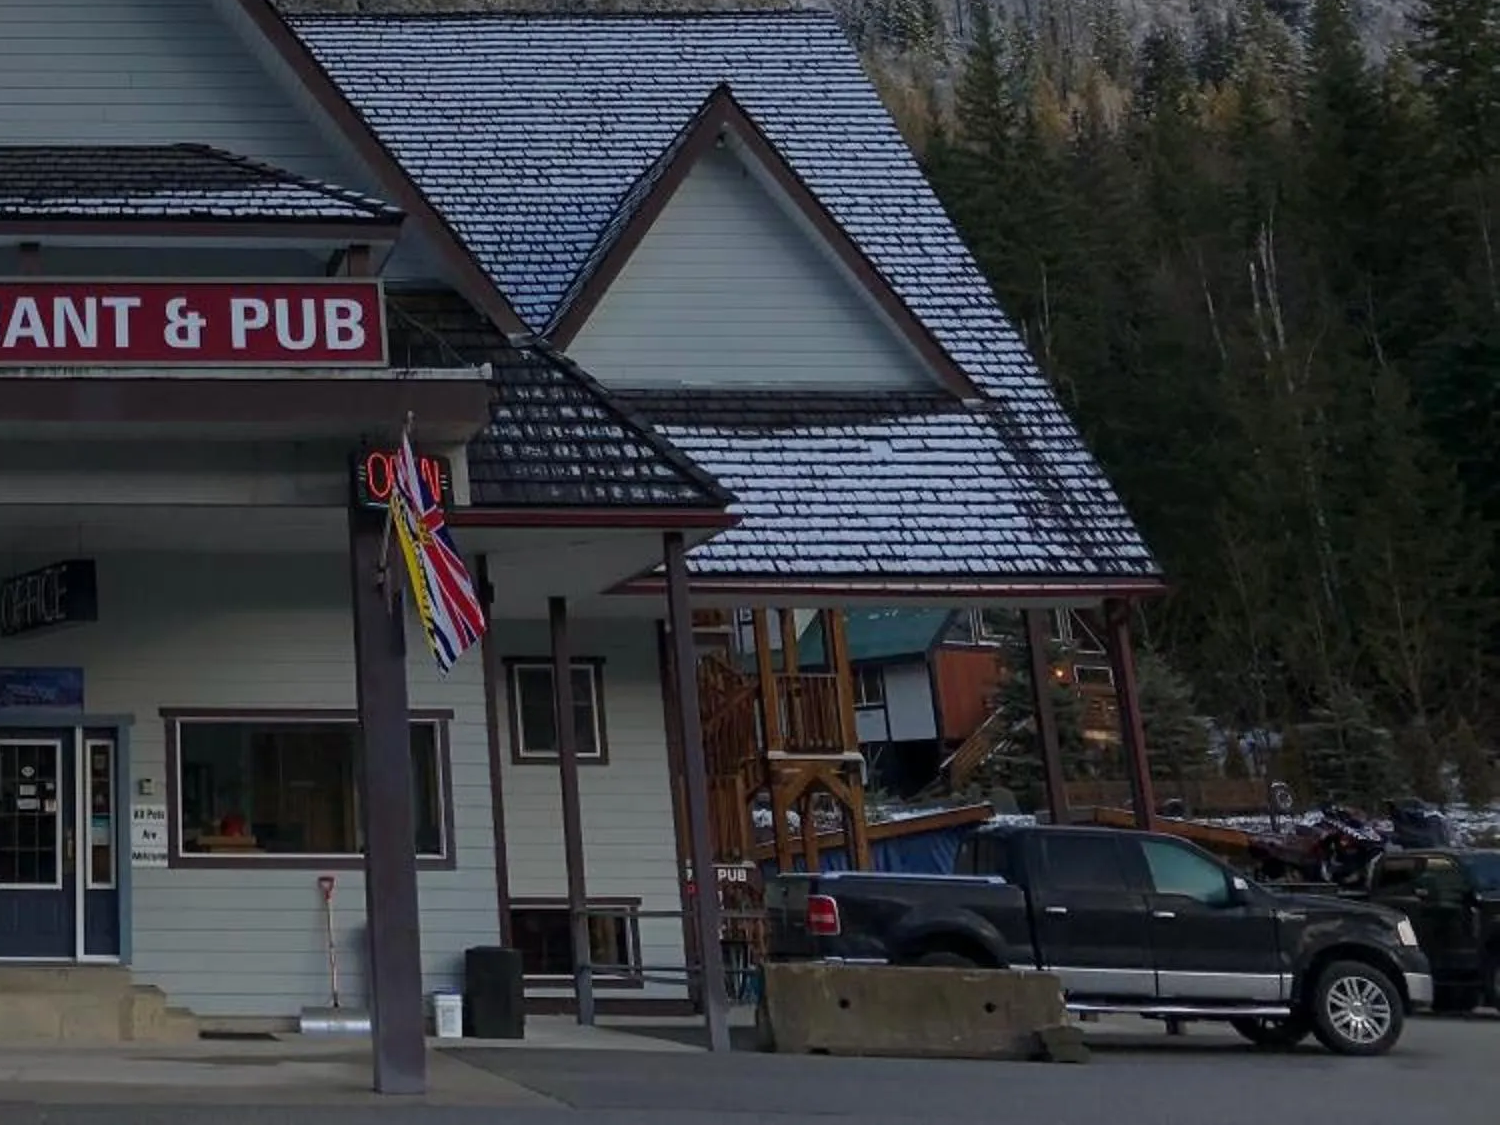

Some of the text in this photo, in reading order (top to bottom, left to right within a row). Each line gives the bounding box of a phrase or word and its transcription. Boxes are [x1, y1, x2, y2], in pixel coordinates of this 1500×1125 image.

[163, 297, 207, 349] &
[230, 297, 366, 351] PUB
[1, 565, 67, 630] OFFICE
[717, 868, 747, 882] PUB
